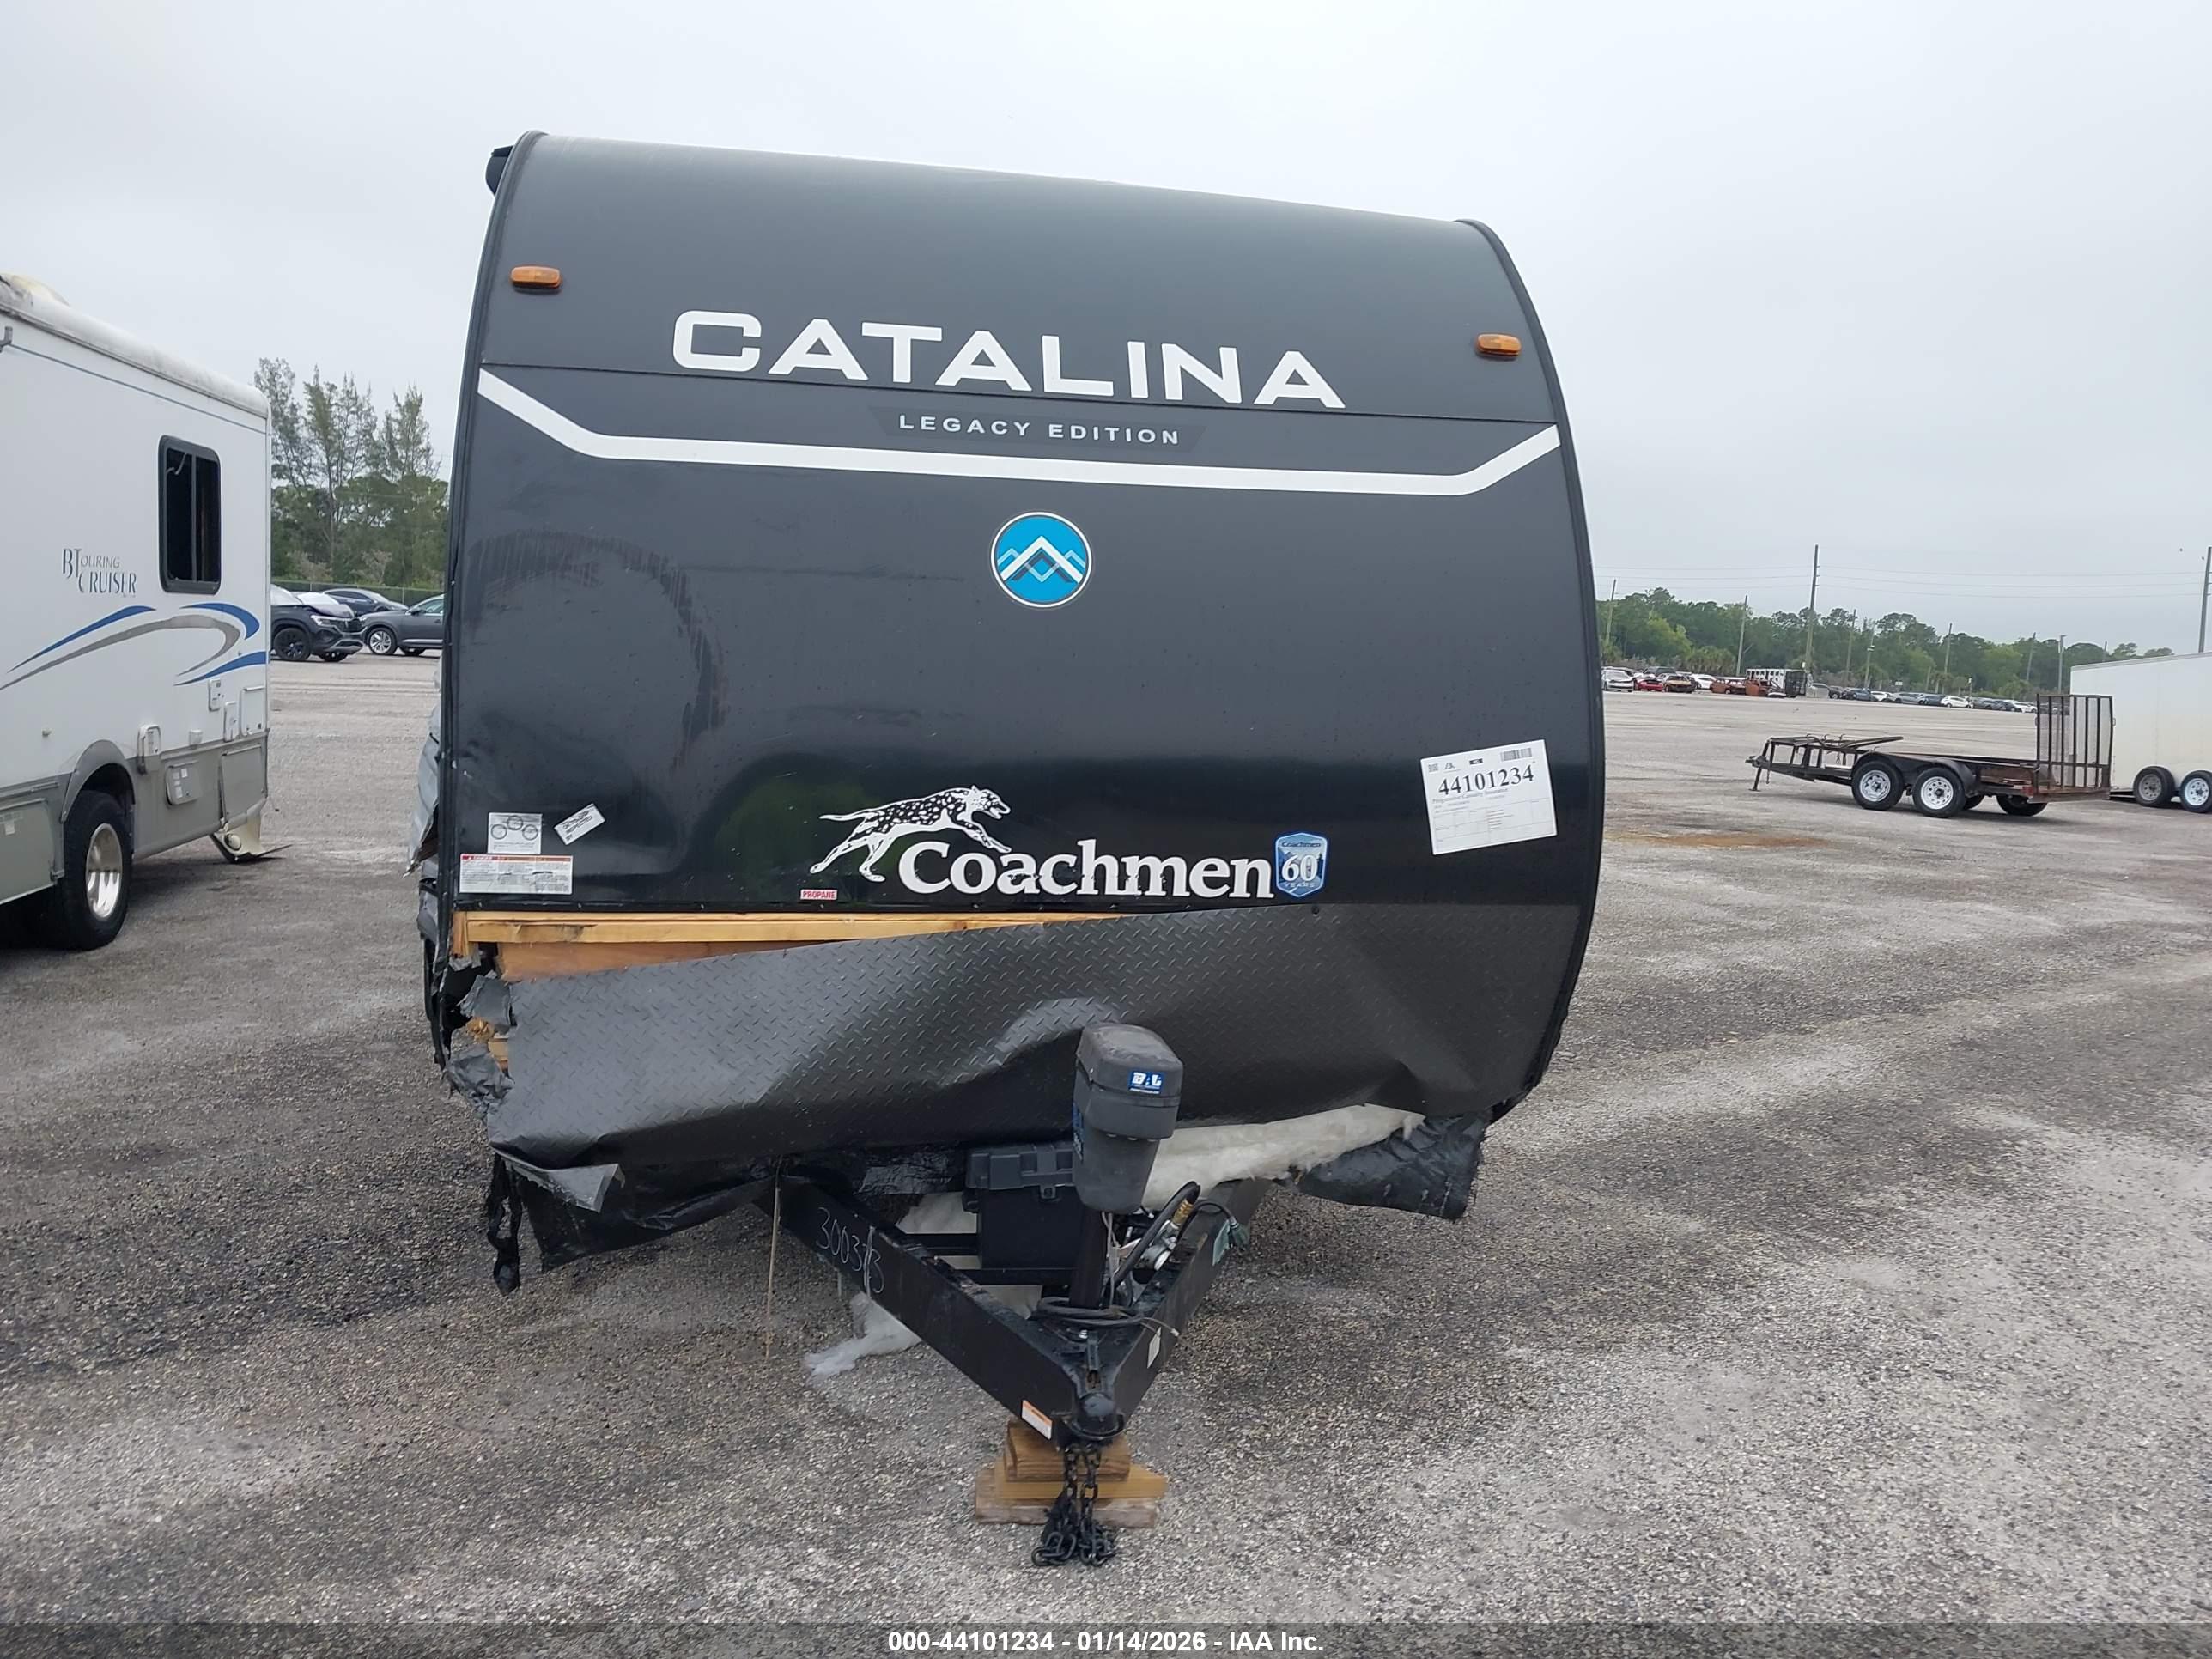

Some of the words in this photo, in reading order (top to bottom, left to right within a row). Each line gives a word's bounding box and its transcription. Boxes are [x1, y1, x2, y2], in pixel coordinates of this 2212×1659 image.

[673, 310, 1346, 409] CATALINA
[899, 415, 1030, 436] LEGACY
[1048, 423, 1179, 445] EDITION
[78, 571, 137, 595] CRUISER
[1439, 764, 1534, 795] 44101234
[898, 839, 1274, 898] Coachmen
[1282, 855, 1317, 882] 60
